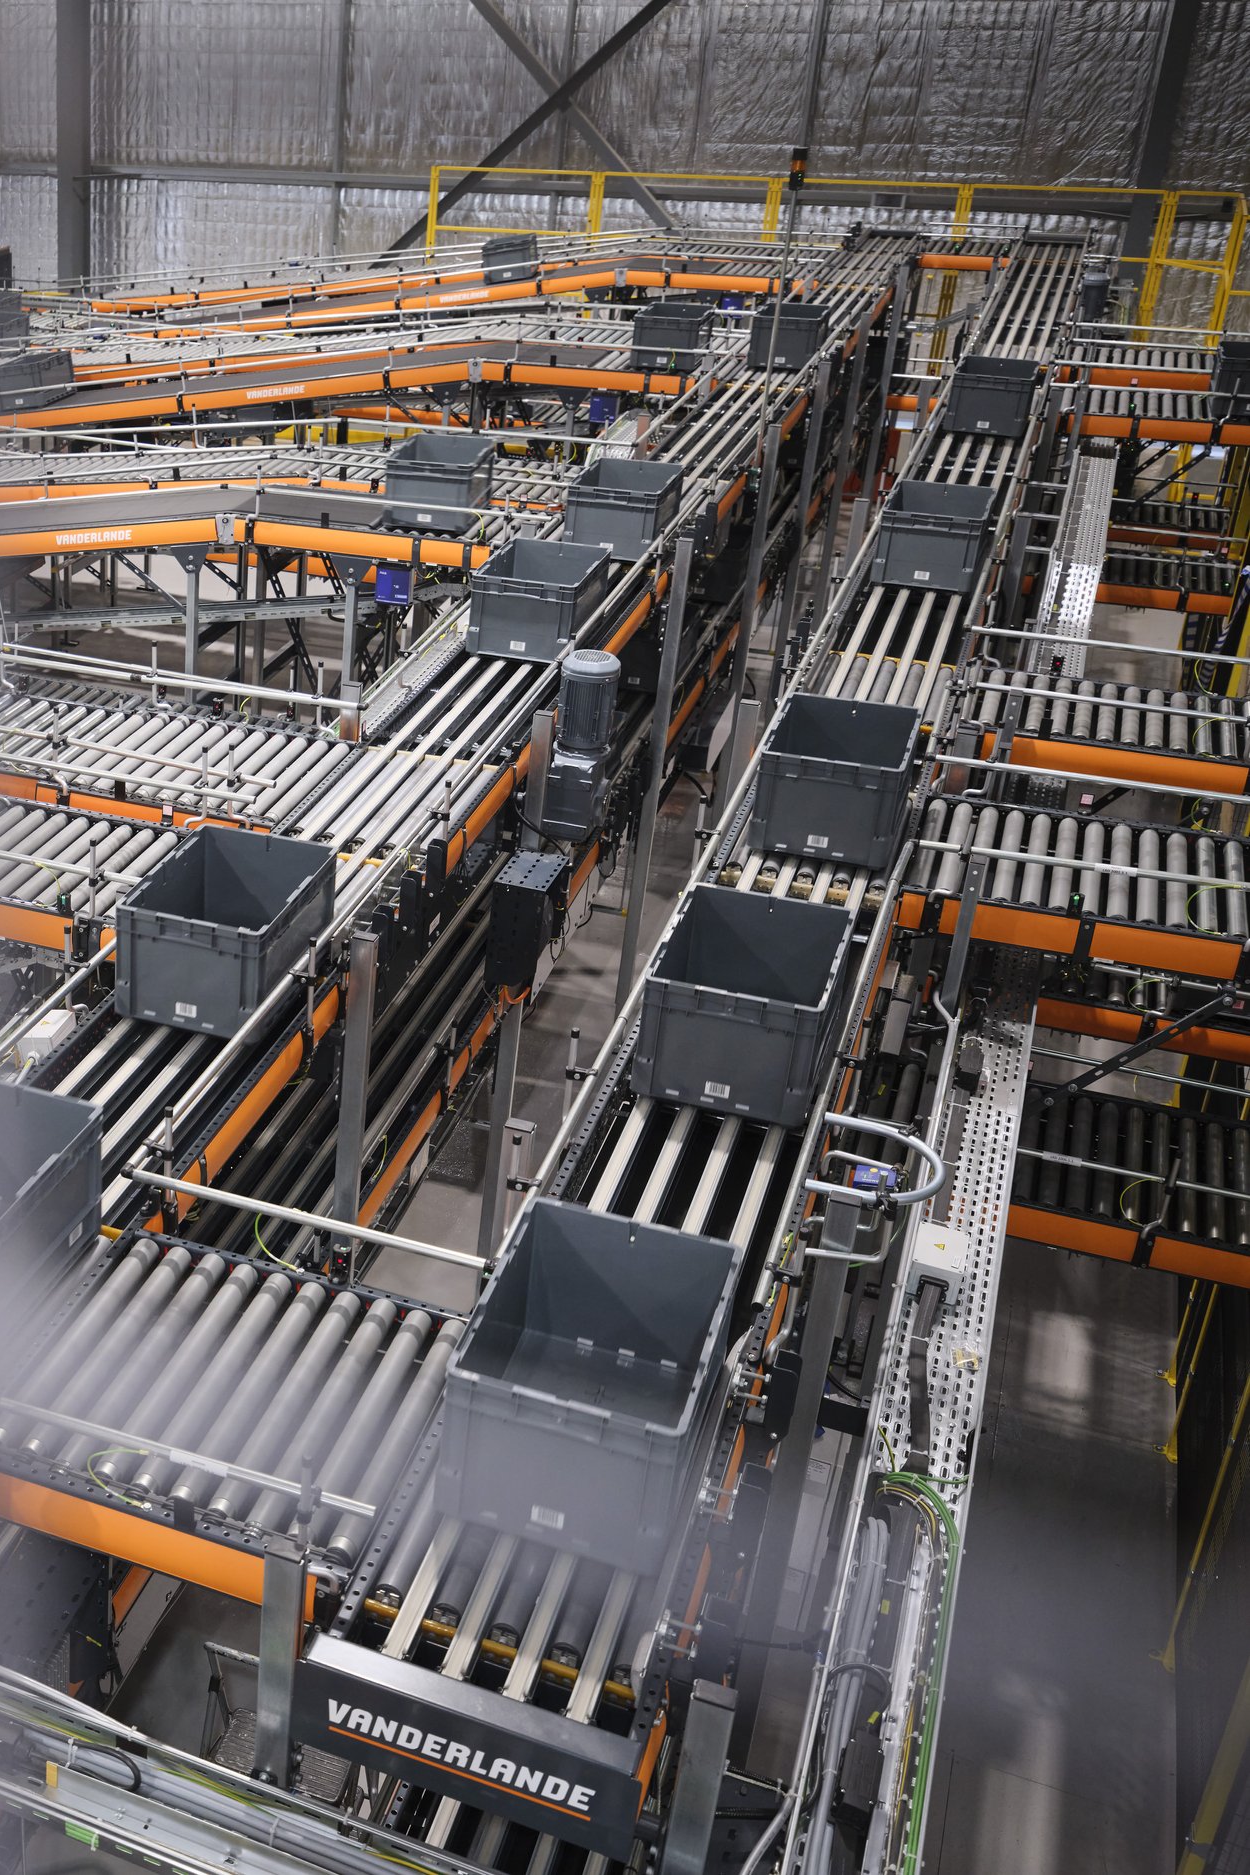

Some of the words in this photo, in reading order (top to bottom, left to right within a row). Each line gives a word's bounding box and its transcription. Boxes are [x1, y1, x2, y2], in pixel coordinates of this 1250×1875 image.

[439, 290, 489, 305] VANDERLANDE
[246, 384, 306, 400] VANDERLANDE
[55, 529, 133, 546] VANDERLANDE
[328, 1698, 597, 1812] VANDERLANDE
